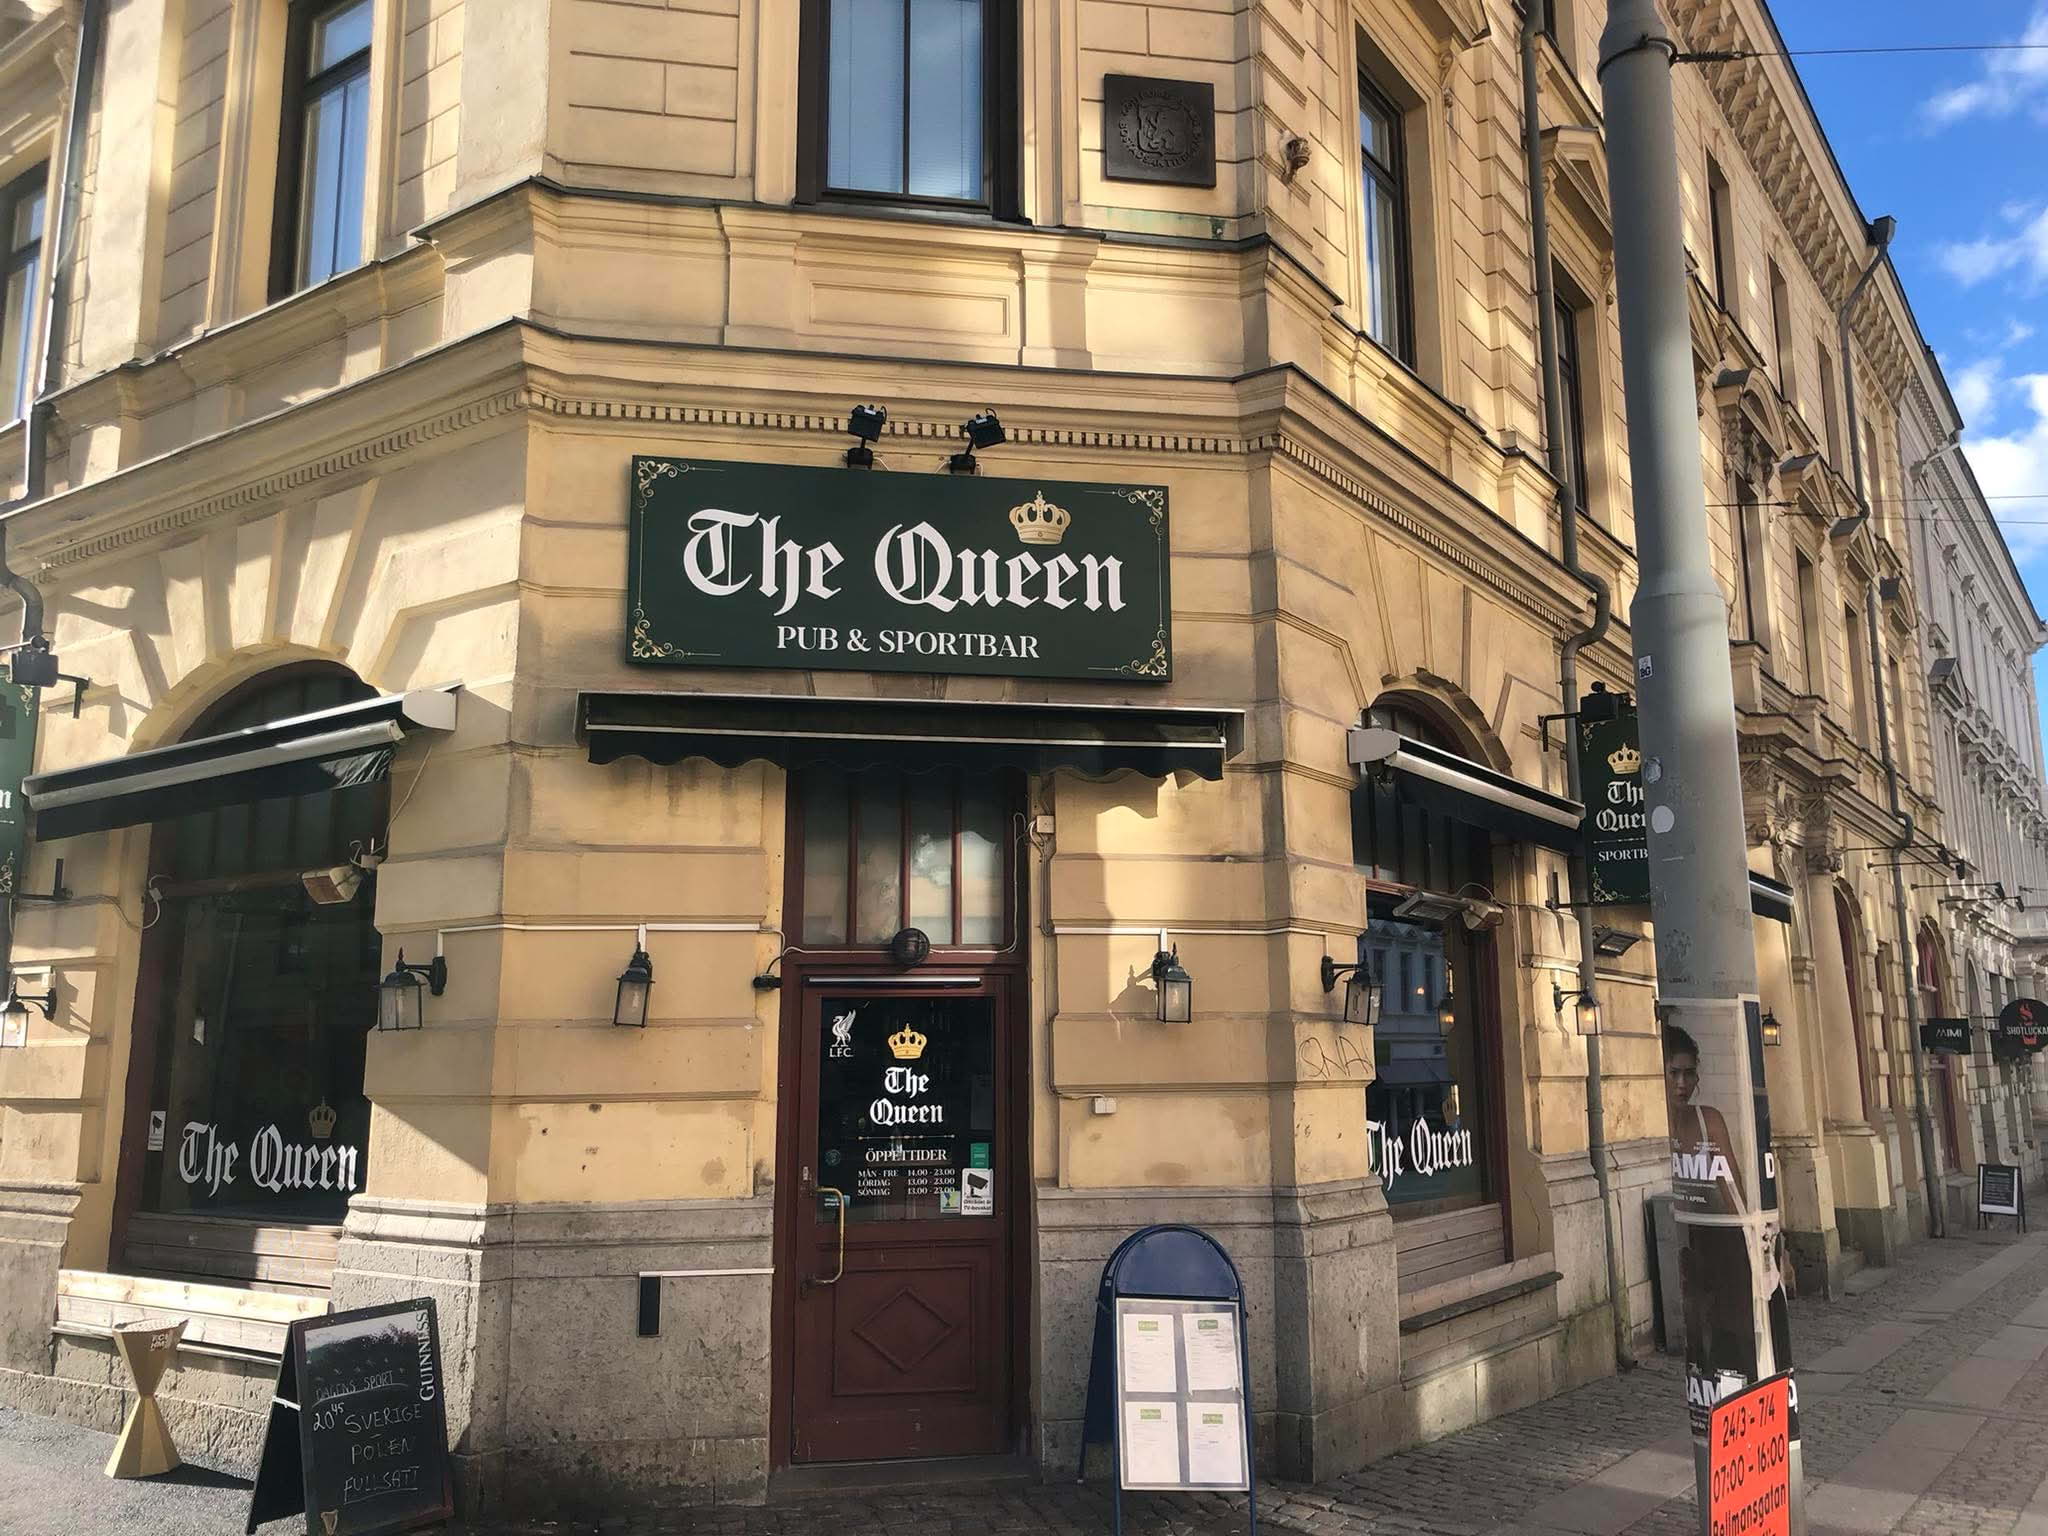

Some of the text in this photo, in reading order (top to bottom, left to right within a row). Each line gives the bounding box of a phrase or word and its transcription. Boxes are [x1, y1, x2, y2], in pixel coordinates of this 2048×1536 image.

[683, 508, 1126, 616] The Queen
[777, 625, 1040, 658] PUB & SPORTBAR
[885, 1066, 929, 1098] The
[870, 1098, 943, 1126] Queen
[179, 1120, 358, 1198] The Queen
[865, 1147, 947, 1162] ÖPPETTIDER
[1366, 1116, 1472, 1191] The Queen
[416, 1312, 435, 1401] GUINNESS
[345, 1404, 422, 1433] SVERIGE
[1723, 1406, 1746, 1448] 24/3
[1759, 1393, 1775, 1427] 7/4
[1713, 1455, 1745, 1503] 07:00
[1758, 1433, 1785, 1474] 16:00
